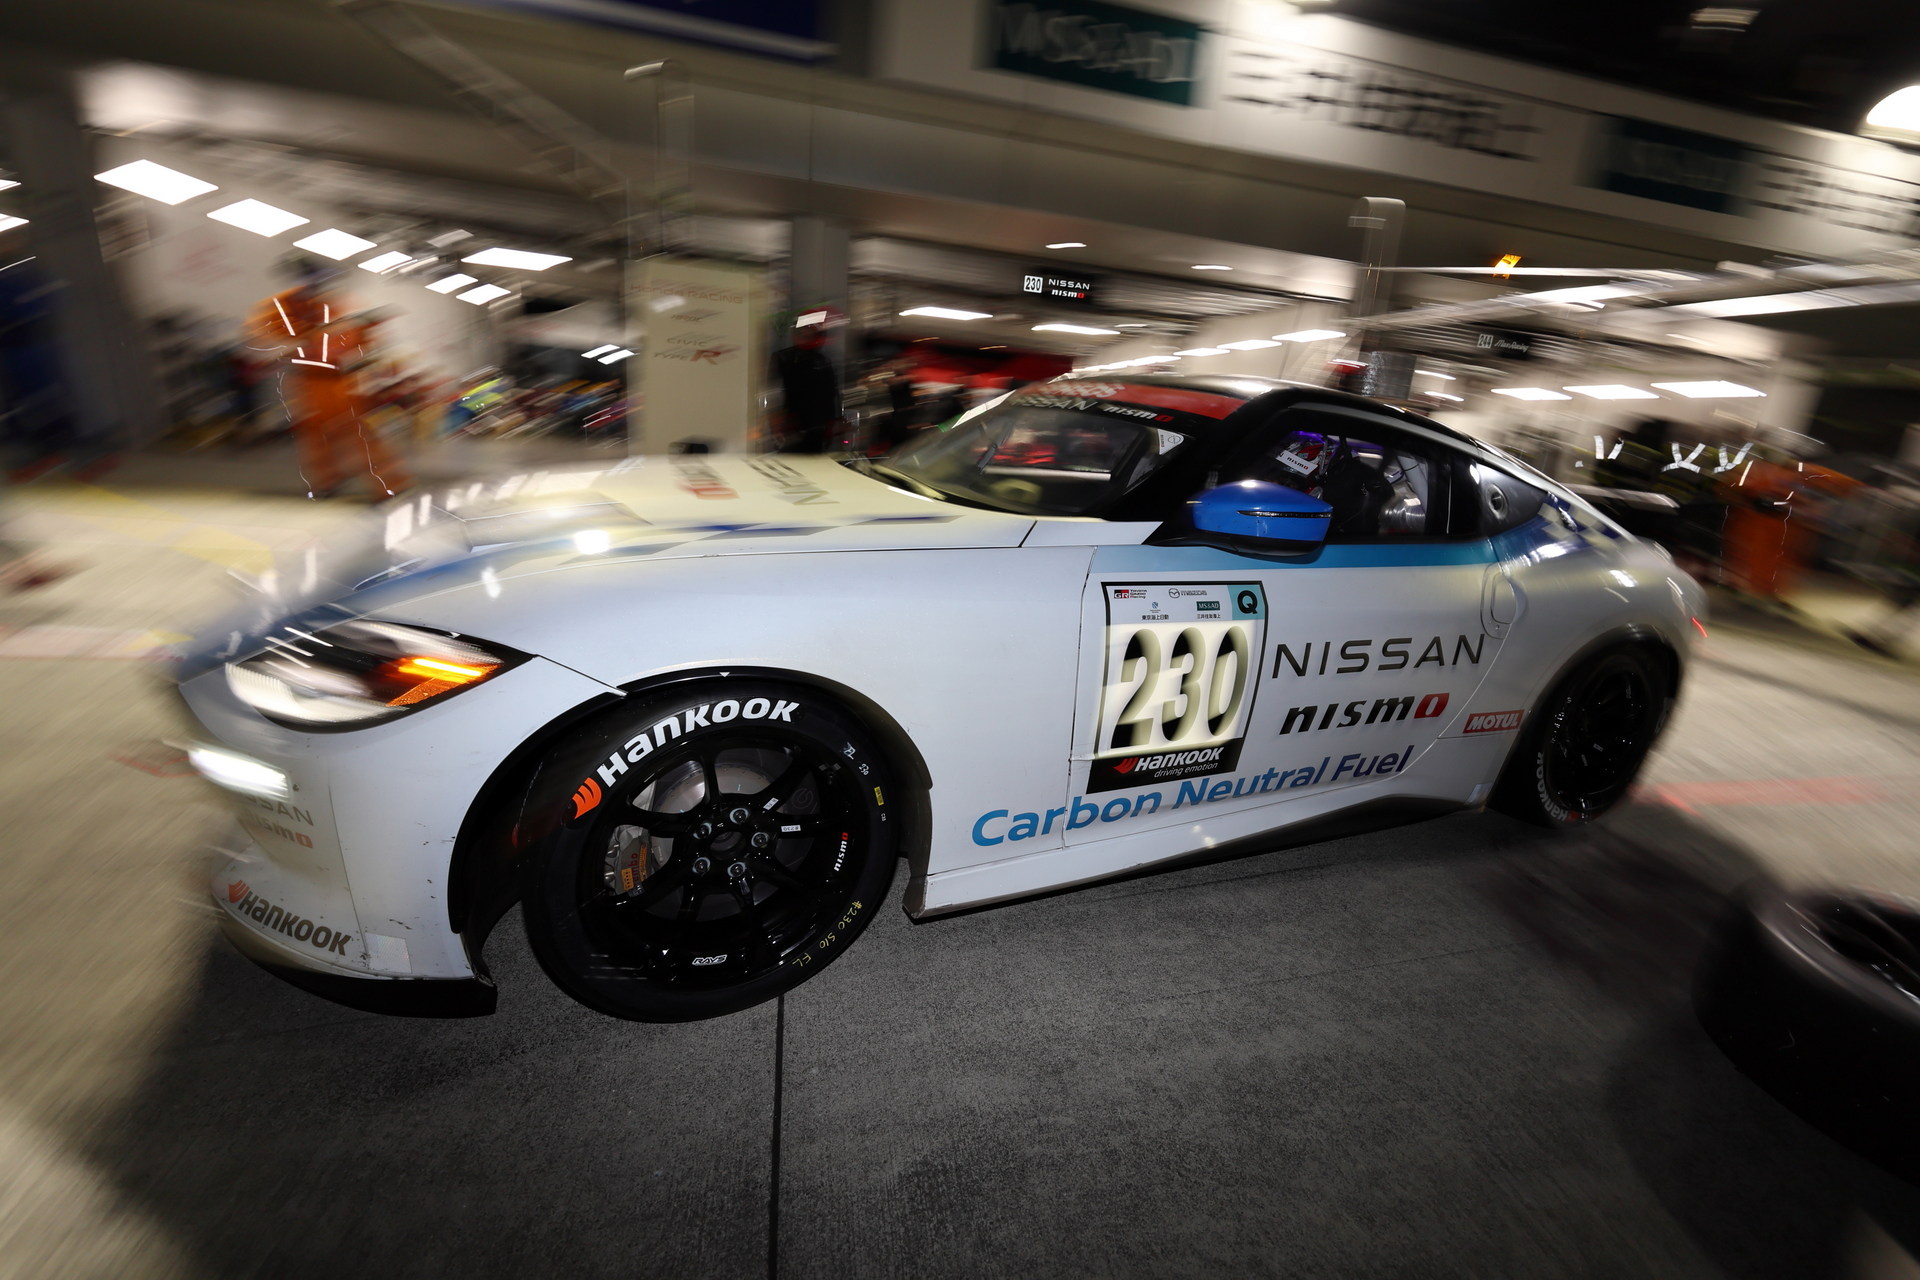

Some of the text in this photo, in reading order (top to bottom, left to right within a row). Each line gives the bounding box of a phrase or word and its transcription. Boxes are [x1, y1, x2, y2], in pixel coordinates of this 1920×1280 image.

[1025, 277, 1041, 291] 230
[1048, 278, 1090, 290] NISSAN
[687, 290, 744, 304] RACING
[1051, 289, 1085, 299] nismo
[1103, 405, 1175, 423] nismo
[1236, 590, 1258, 615] Q
[1271, 633, 1485, 679] NISSAN
[1110, 625, 1249, 749] 230
[1279, 692, 1450, 736] nismo
[1465, 712, 1519, 732] MOTUL
[1154, 761, 1218, 778] driving emotion
[971, 745, 1414, 847] Carbon Neutral Fuel
[833, 831, 849, 872] nismo
[837, 900, 863, 930] #230
[692, 954, 728, 966] RAYS
[792, 952, 812, 967] FL
